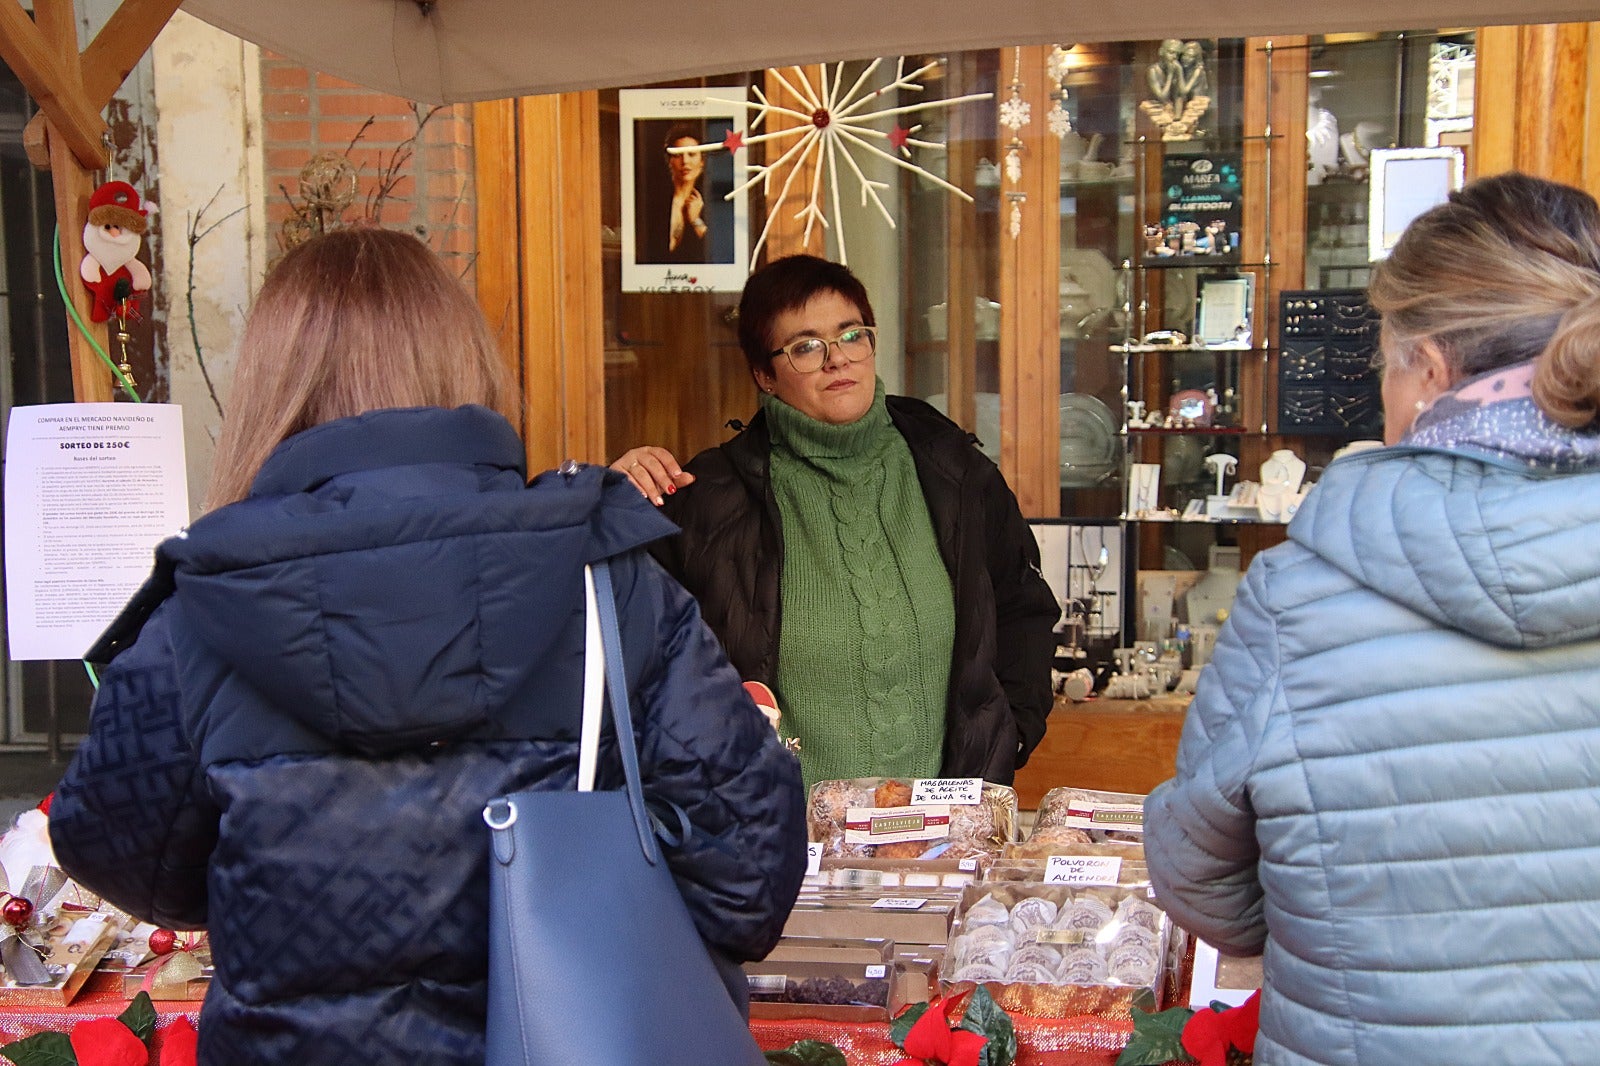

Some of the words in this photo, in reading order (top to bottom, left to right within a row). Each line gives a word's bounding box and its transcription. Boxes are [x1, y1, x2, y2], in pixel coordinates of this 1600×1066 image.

[1183, 174, 1221, 183] MAREA
[1168, 202, 1232, 211] BLUETOOTH
[106, 441, 130, 449] 250€
[920, 779, 974, 787] MAGDALENAS
